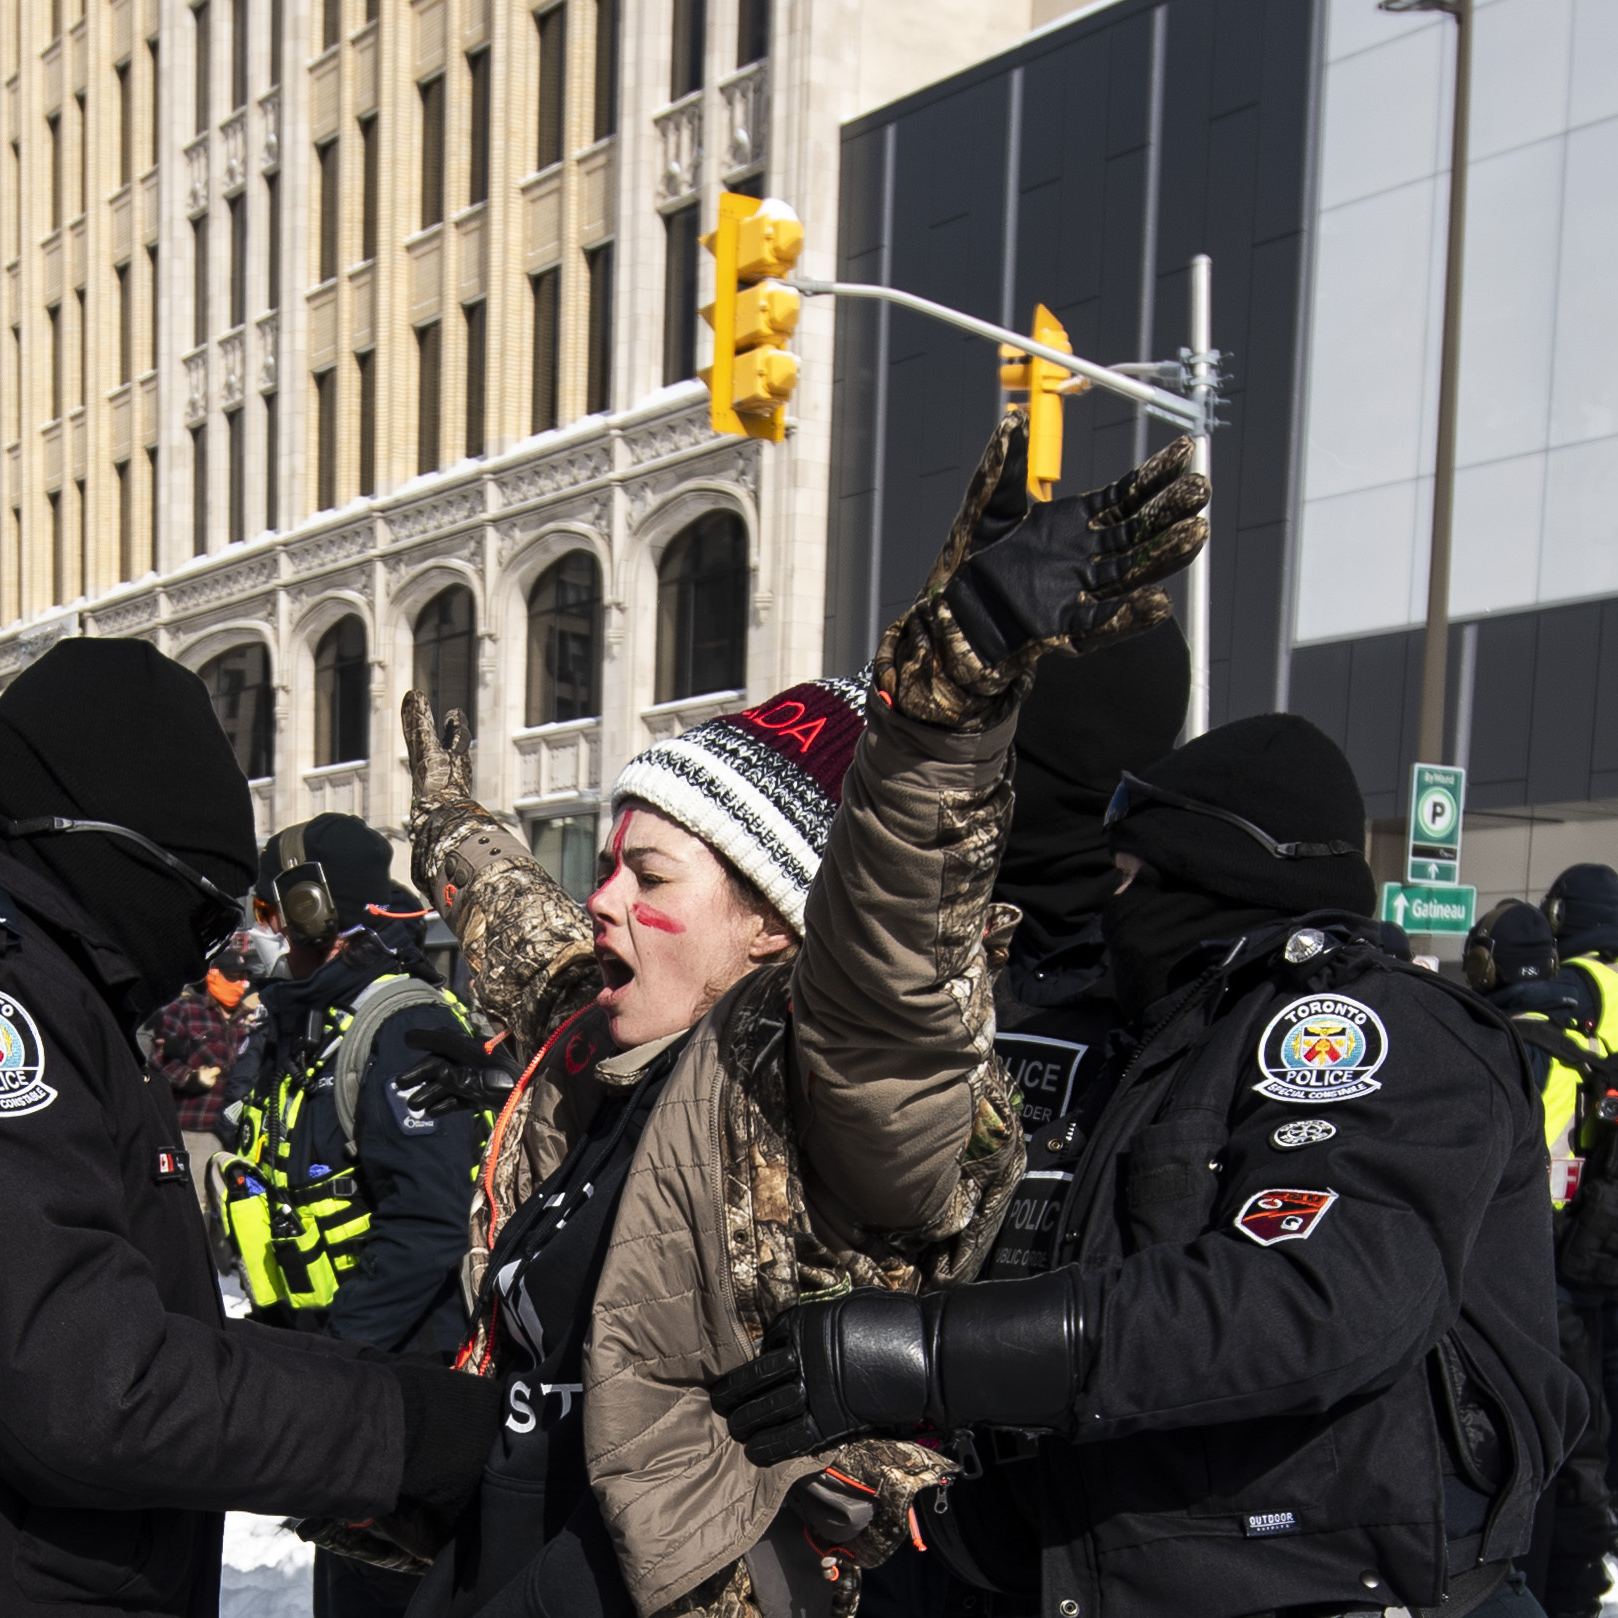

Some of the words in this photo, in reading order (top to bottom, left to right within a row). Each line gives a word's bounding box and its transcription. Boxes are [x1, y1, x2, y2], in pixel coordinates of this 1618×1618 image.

[1412, 898, 1466, 920] Gatineau
[1284, 1001, 1368, 1025] TORONTO
[996, 1055, 1061, 1092] ICE
[1286, 1070, 1354, 1086] POLICE
[0, 1087, 46, 1109] CONSTABLE
[1267, 1083, 1307, 1098] SPECIAL
[1308, 1083, 1367, 1099] CONSTABLE
[1019, 1103, 1053, 1122] DER
[1249, 1512, 1294, 1526] OUTDOOR
